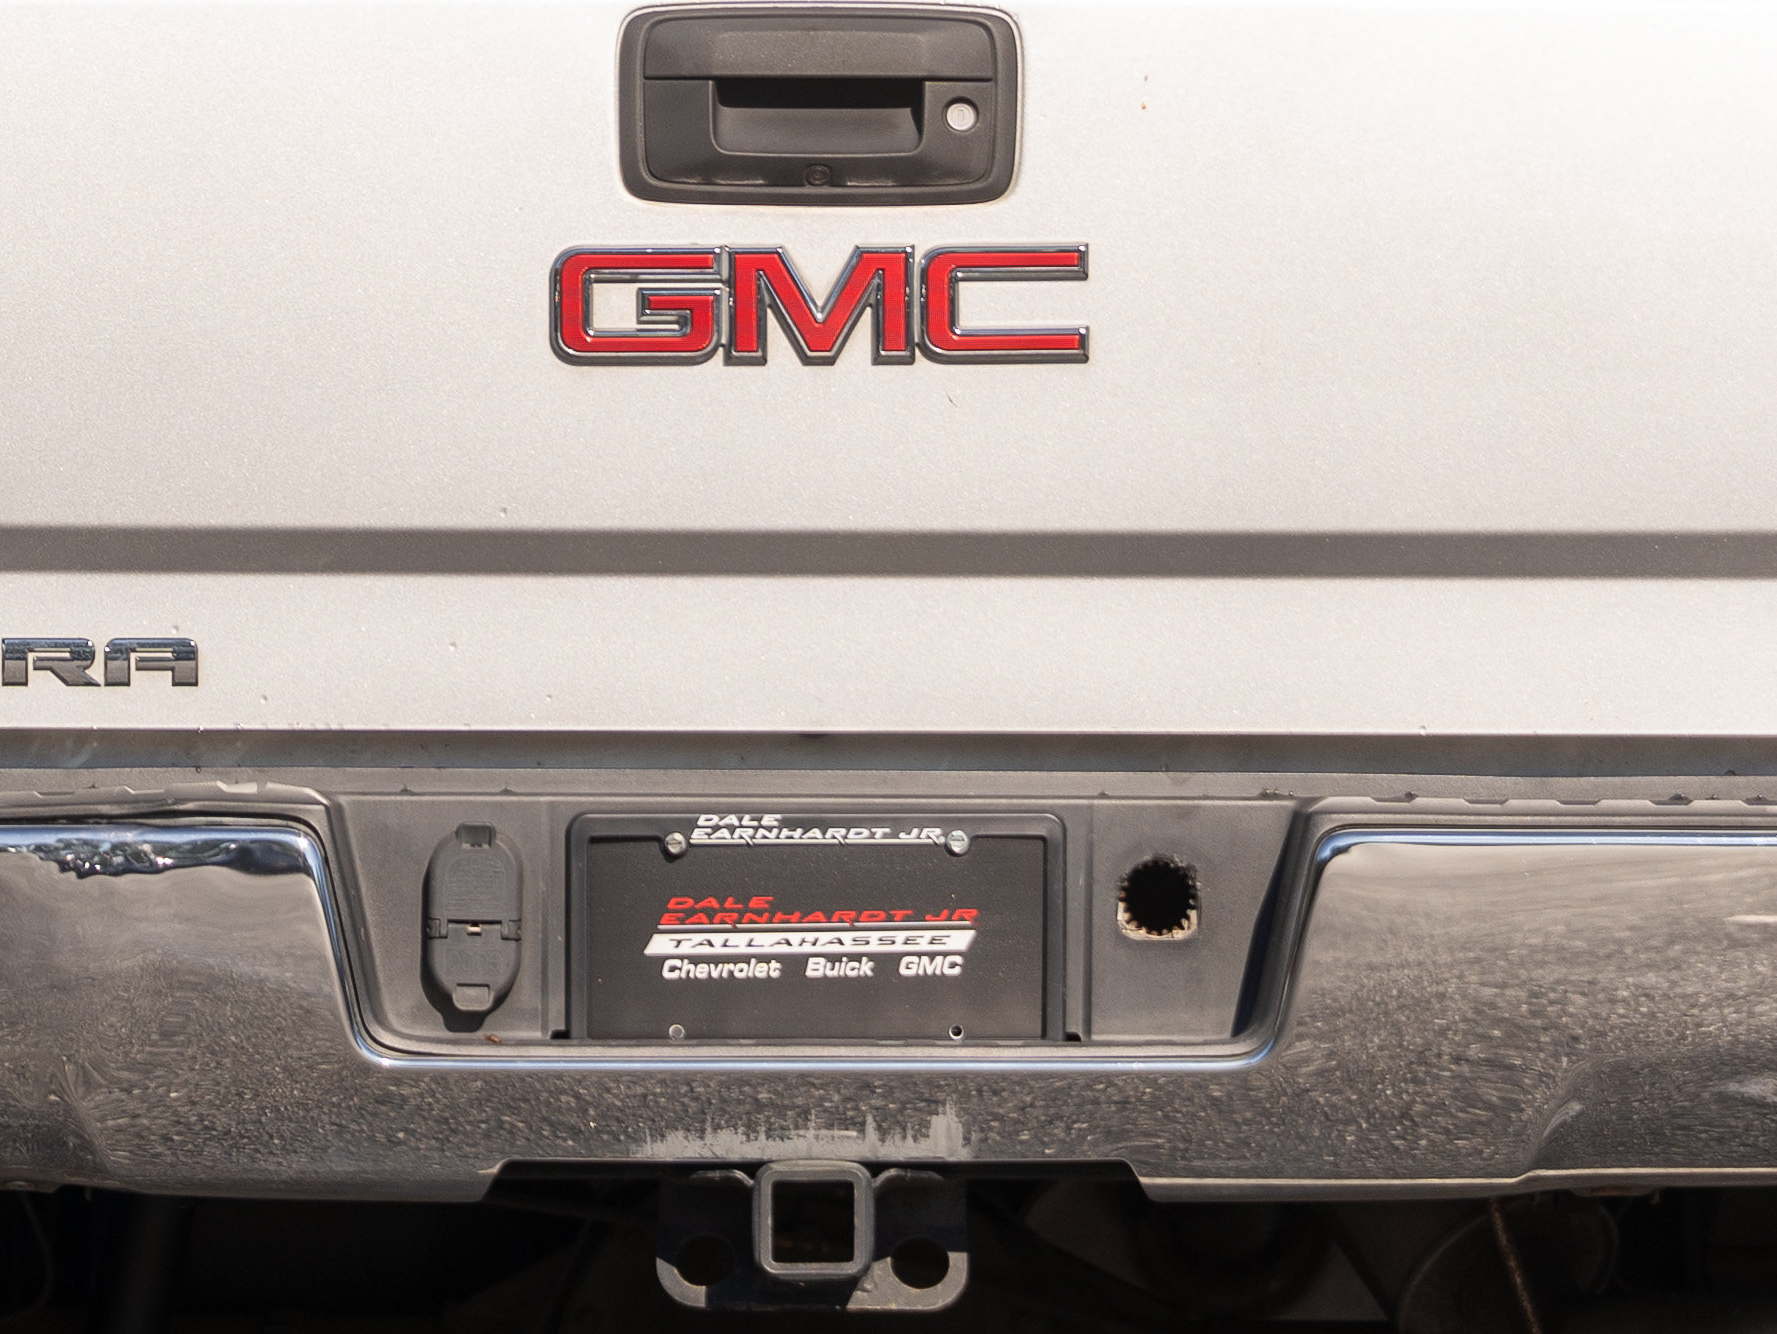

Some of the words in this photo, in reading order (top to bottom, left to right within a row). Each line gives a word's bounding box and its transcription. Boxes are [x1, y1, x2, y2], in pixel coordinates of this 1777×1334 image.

[548, 242, 1090, 366] GMC
[696, 814, 781, 827] DALE
[690, 828, 891, 845] EARNHARDT
[667, 897, 774, 910] DALE
[659, 910, 914, 927] EARNHARDT
[668, 935, 951, 949] TALLAHASSEE
[661, 958, 782, 980] Chevrolet
[804, 956, 875, 978] Buick
[897, 955, 965, 977] GMC
